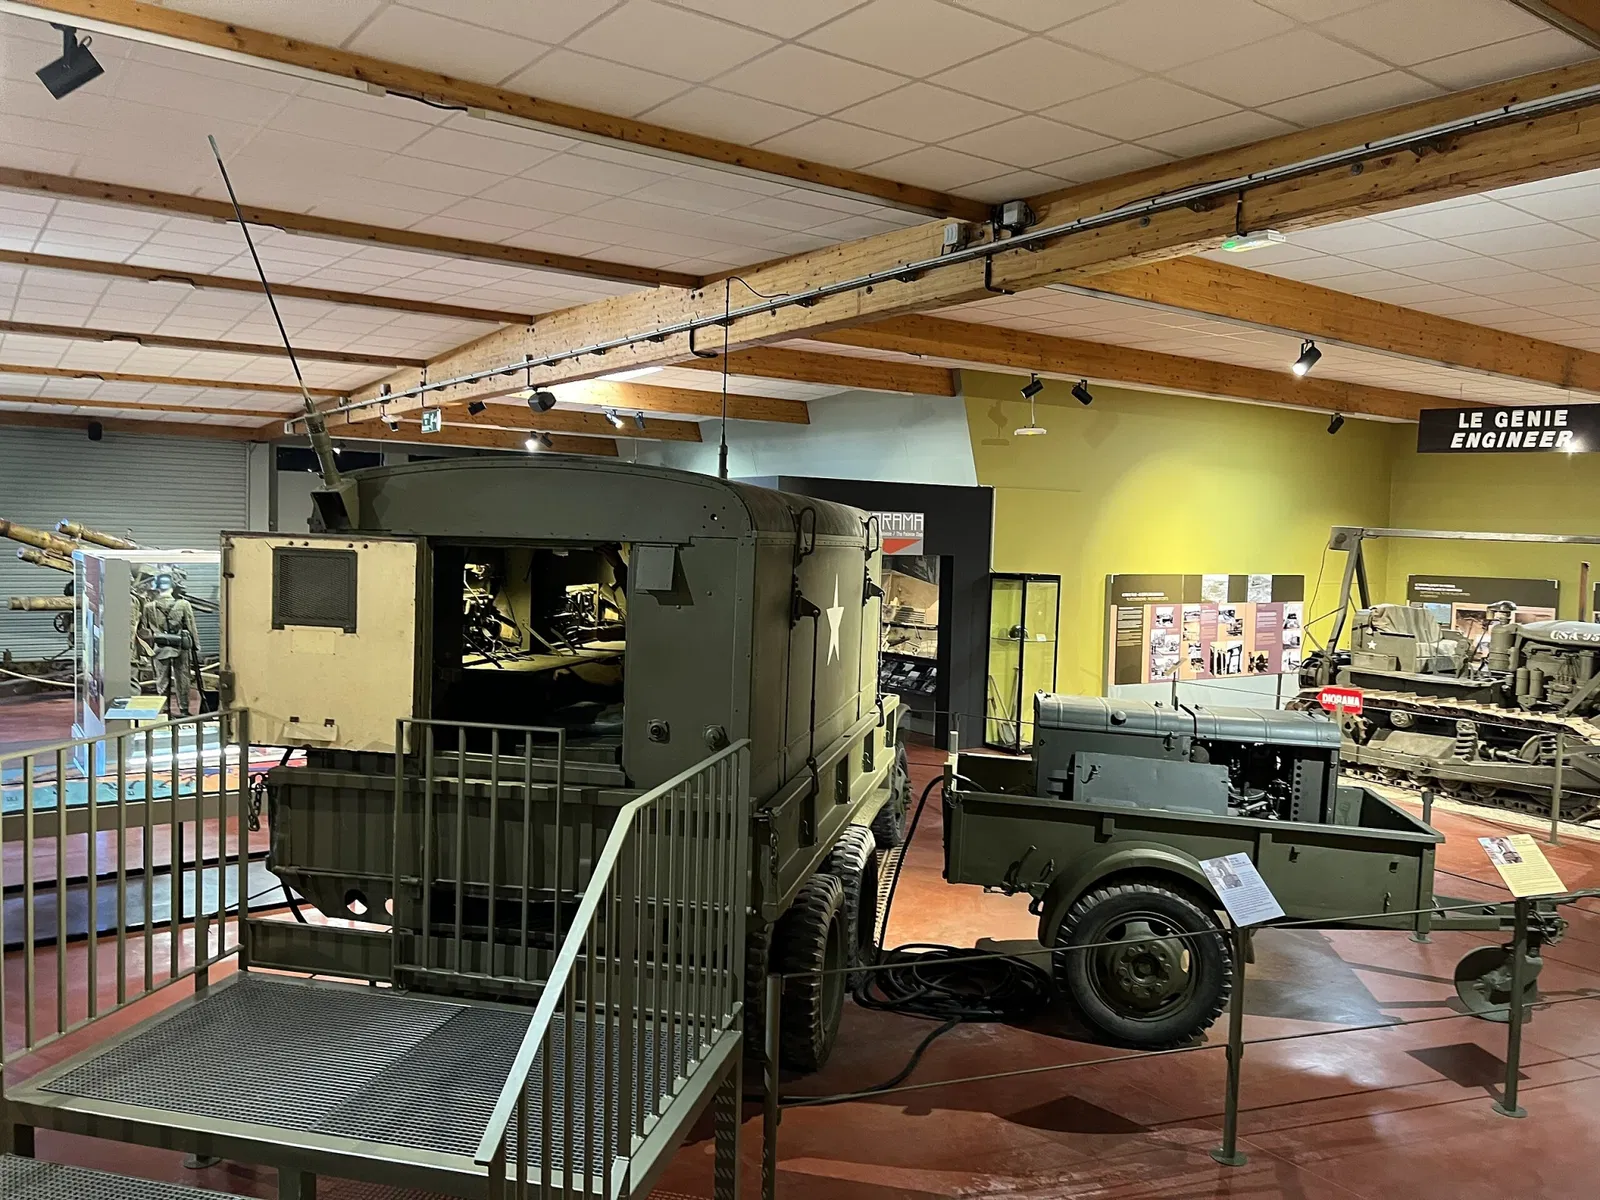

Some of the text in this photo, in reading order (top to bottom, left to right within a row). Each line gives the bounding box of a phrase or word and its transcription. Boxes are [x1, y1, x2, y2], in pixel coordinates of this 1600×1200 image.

[1458, 412, 1484, 428] LE
[1450, 430, 1575, 449] ENGINEER
[1321, 693, 1360, 707] DIORAMA
